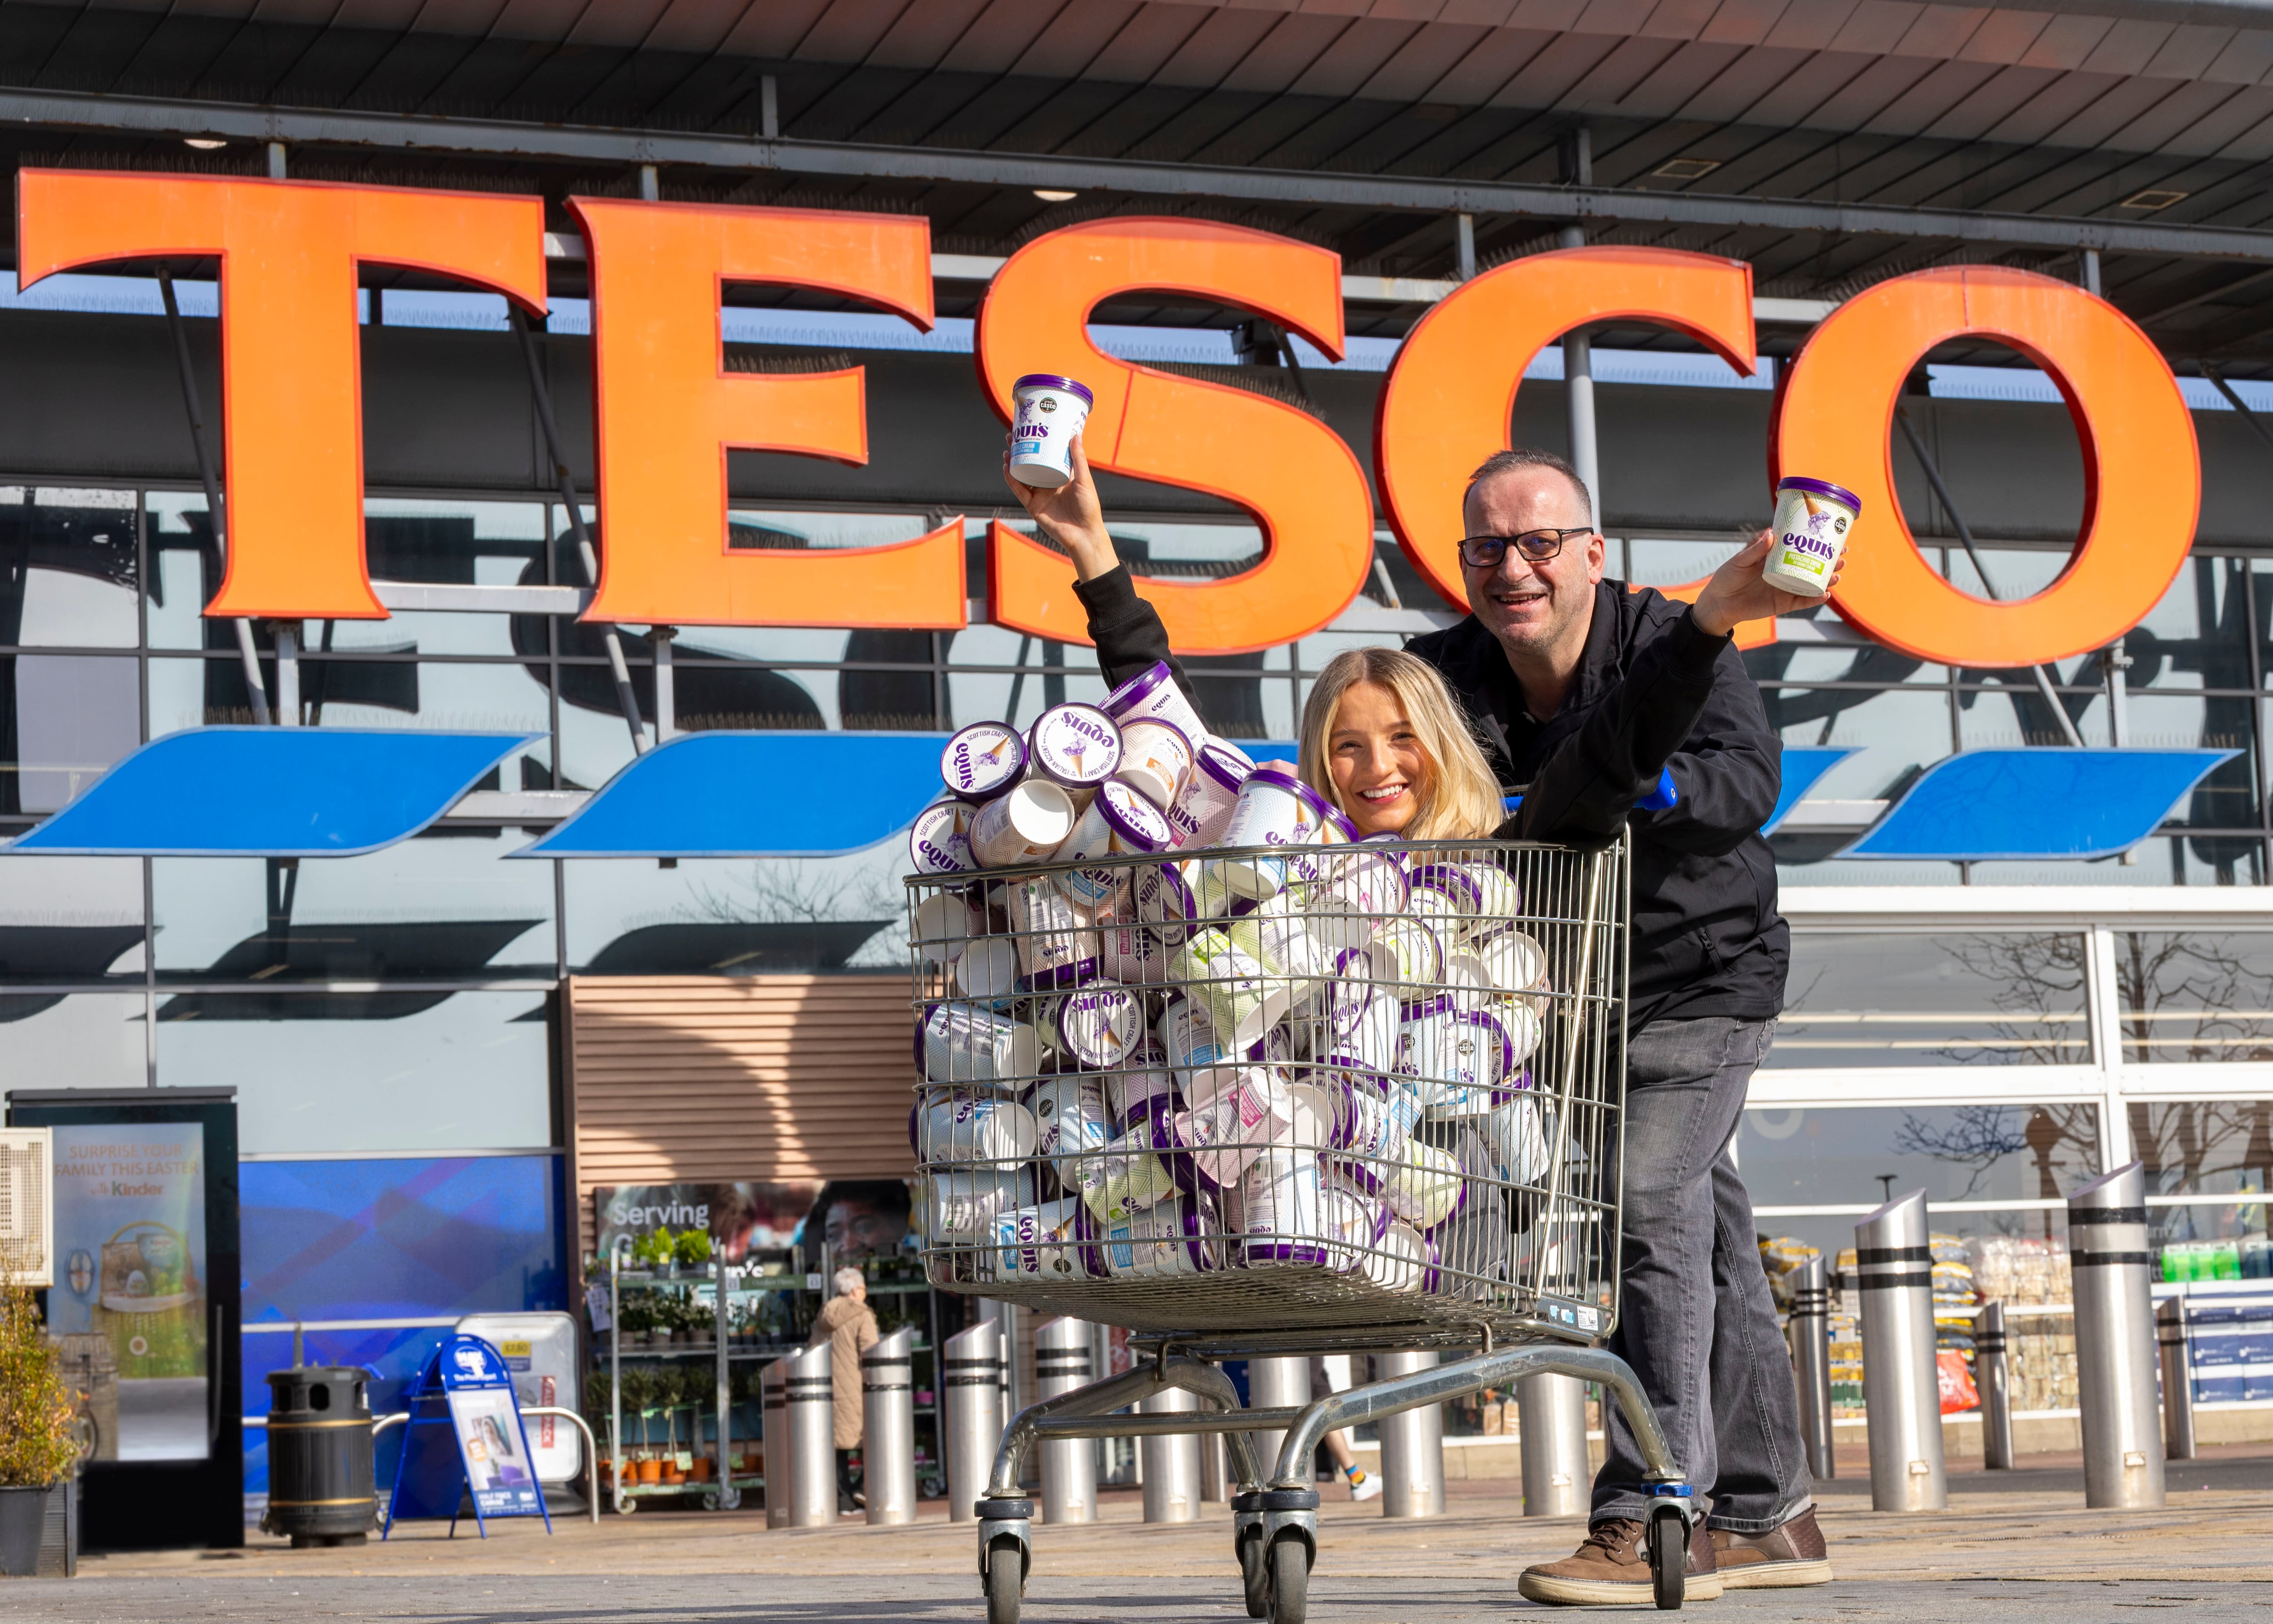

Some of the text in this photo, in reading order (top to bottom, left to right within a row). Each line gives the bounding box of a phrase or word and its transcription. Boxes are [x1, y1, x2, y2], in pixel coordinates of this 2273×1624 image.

[17, 167, 2202, 669] TESCO
[1788, 553, 1810, 564] PISTACHIO
[967, 730, 1006, 741] SCOTTISH CRAFT
[1003, 740, 1018, 778] ITALIAN ACCENT
[1041, 745, 1070, 775] ITALIAN ACCENT
[1084, 750, 1115, 777] SCOTTISH CRAFT
[1136, 796, 1152, 811] ITALIAN
[920, 814, 938, 836] SCOTTISH
[937, 808, 954, 819] CRAFT
[1073, 871, 1090, 884] DOUBLE
[1124, 1003, 1136, 1046] SCOTTISH CRAFT
[1094, 1050, 1113, 1059] ITALAN
[70, 1144, 182, 1159] SURPRISE YOUR
[54, 1160, 199, 1177] FAMILY THIS EASTER
[612, 1200, 710, 1229] Serving
[454, 1373, 465, 1381] The
[543, 1415, 552, 1444] PACK
